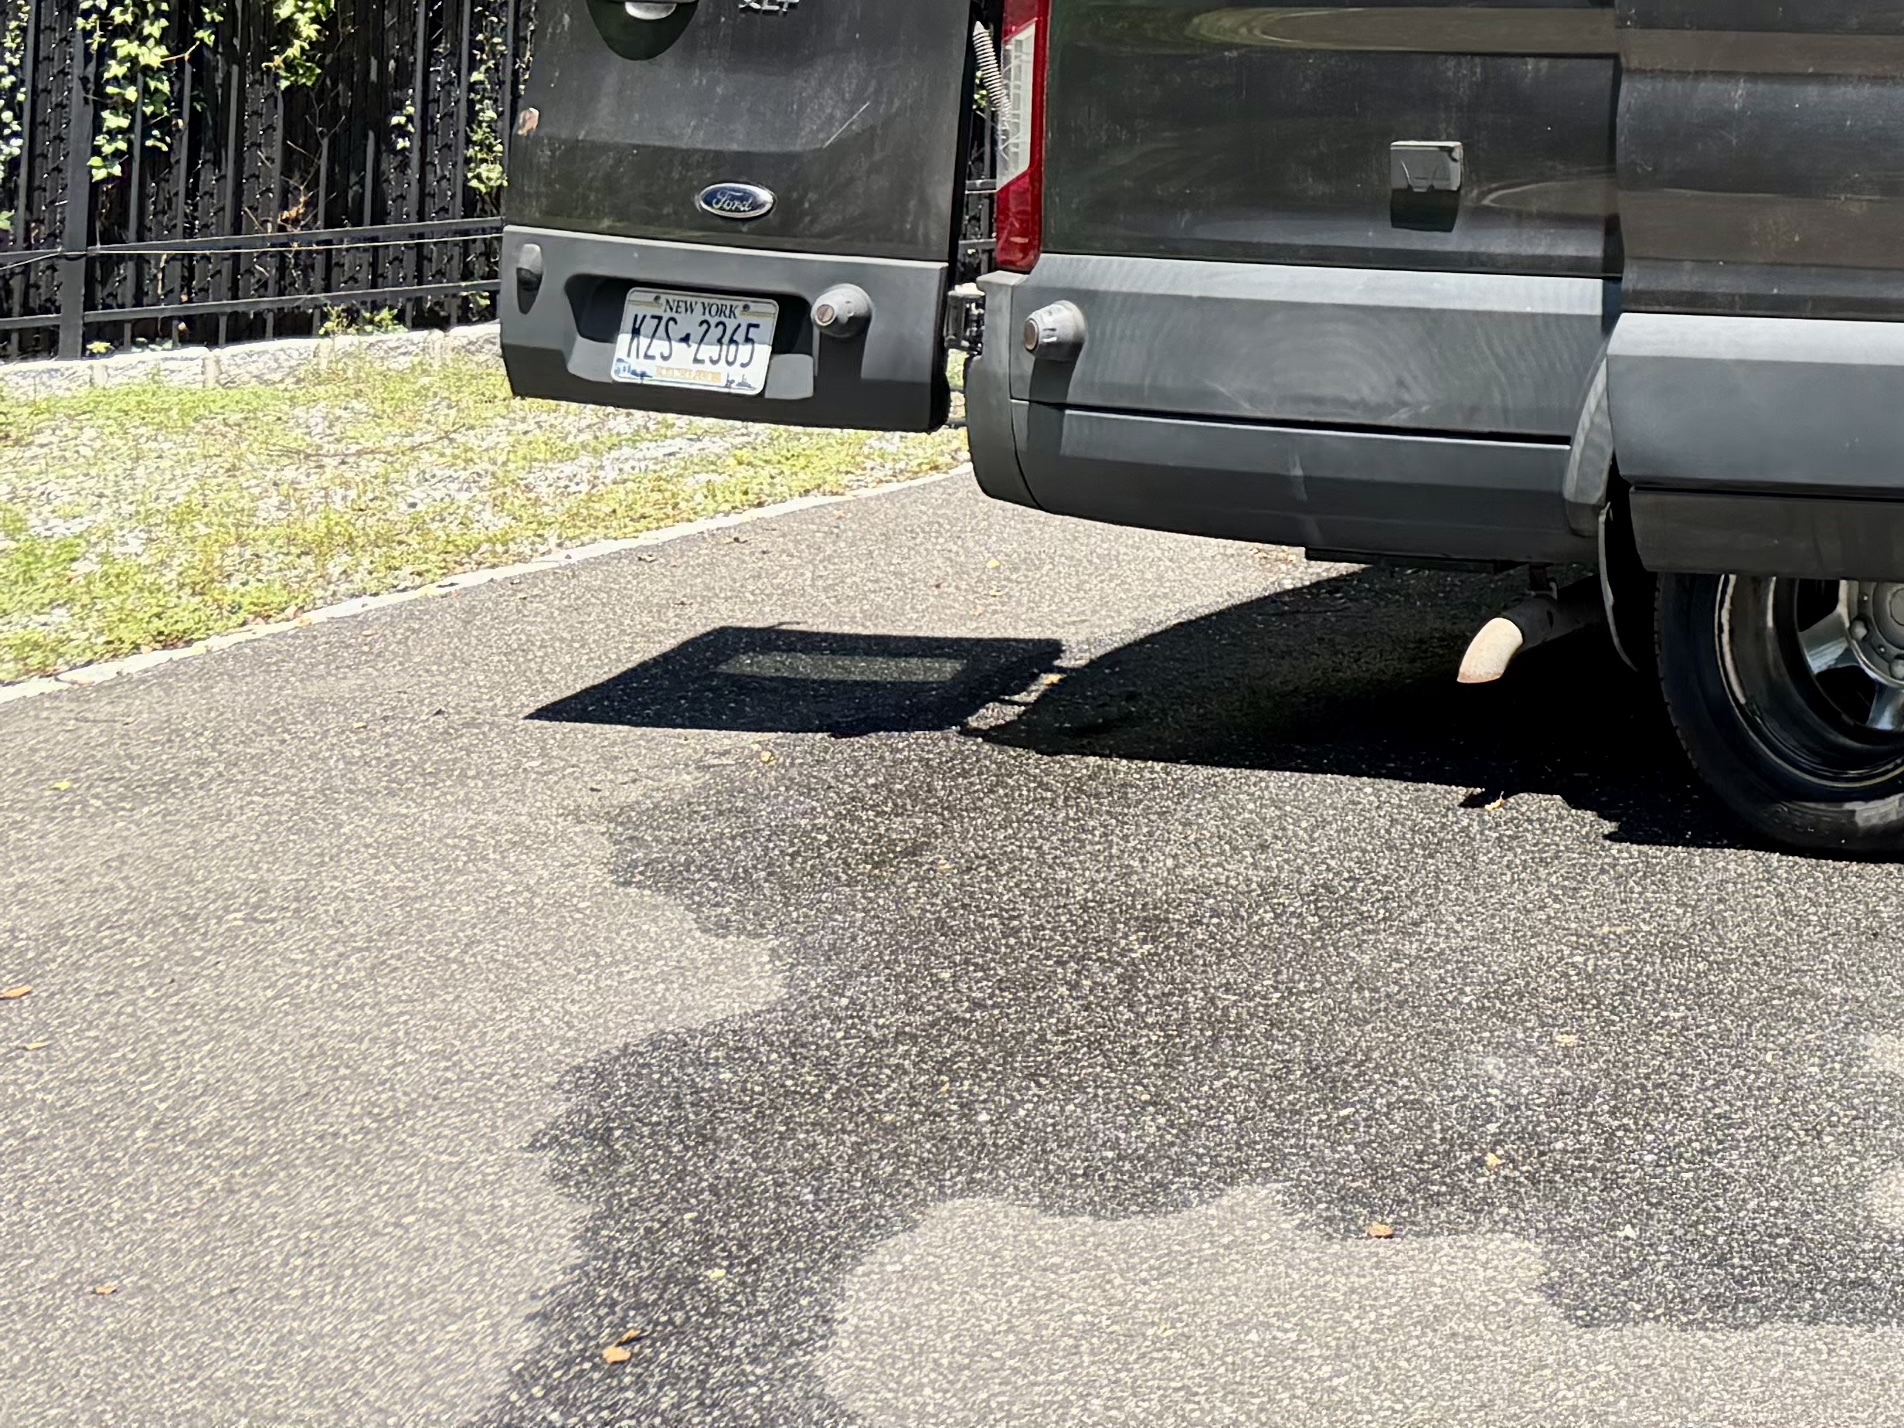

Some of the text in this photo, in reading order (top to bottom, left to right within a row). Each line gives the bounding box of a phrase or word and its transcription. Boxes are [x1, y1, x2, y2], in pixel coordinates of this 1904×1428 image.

[663, 298, 740, 320] NEW YORK
[626, 313, 760, 369] KZS 2365
